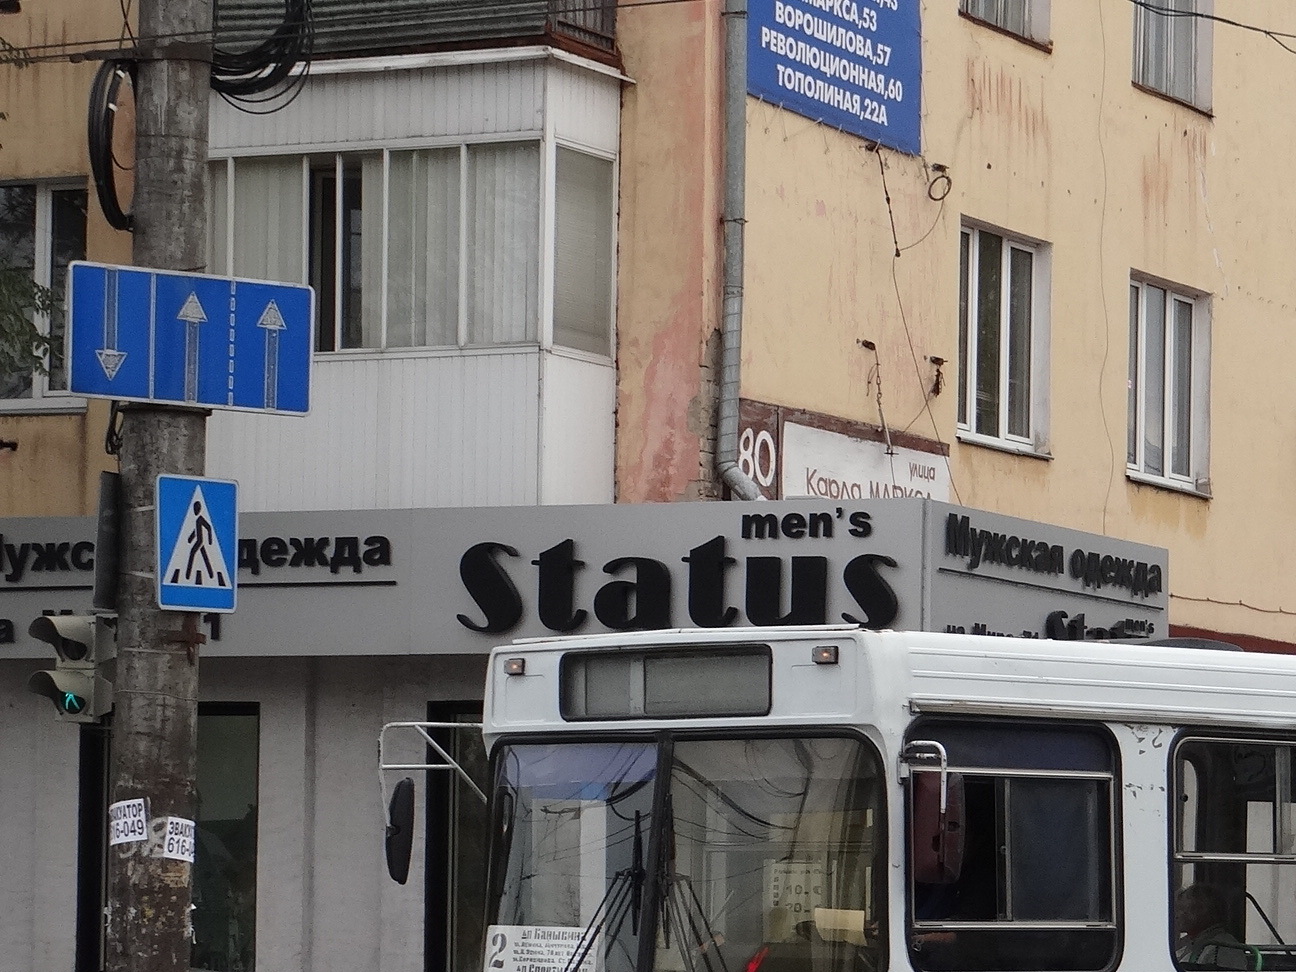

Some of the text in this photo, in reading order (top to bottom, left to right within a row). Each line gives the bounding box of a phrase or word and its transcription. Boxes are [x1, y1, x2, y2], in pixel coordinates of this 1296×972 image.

[761, 26, 903, 102] РЕВОЛЮЦИОННАЯ,60
[775, 1, 892, 67] ВОРОШИЛОВА,57
[776, 63, 889, 127] ТОПОЛИНАЯ,22А
[738, 427, 776, 488] 80
[908, 461, 936, 483] улица
[741, 506, 873, 539] men's
[238, 534, 392, 575] дежда
[455, 536, 899, 634] Status
[945, 512, 1163, 598] Мужская одежда
[488, 933, 507, 969] 2
